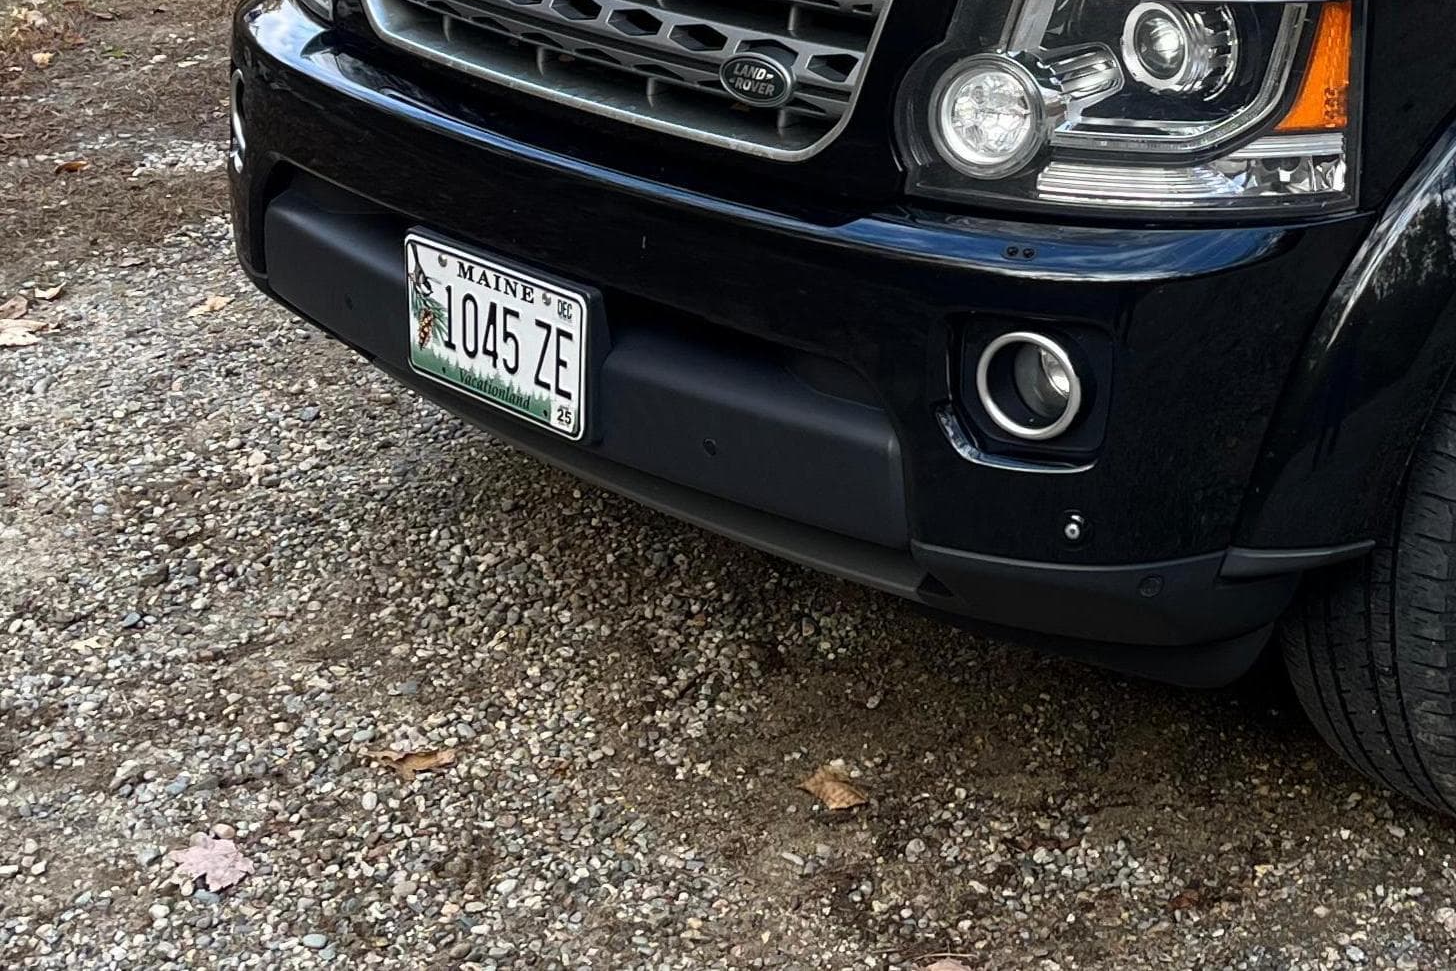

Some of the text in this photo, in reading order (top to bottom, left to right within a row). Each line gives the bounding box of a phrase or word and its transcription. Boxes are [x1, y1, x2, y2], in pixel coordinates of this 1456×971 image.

[733, 63, 767, 80] LAND
[734, 77, 776, 97] ROVER
[456, 261, 535, 304] MAINE
[556, 299, 573, 320] DEC
[444, 285, 574, 401] 1045 ZE
[459, 367, 531, 410] Vacationland
[556, 408, 572, 425] 25
